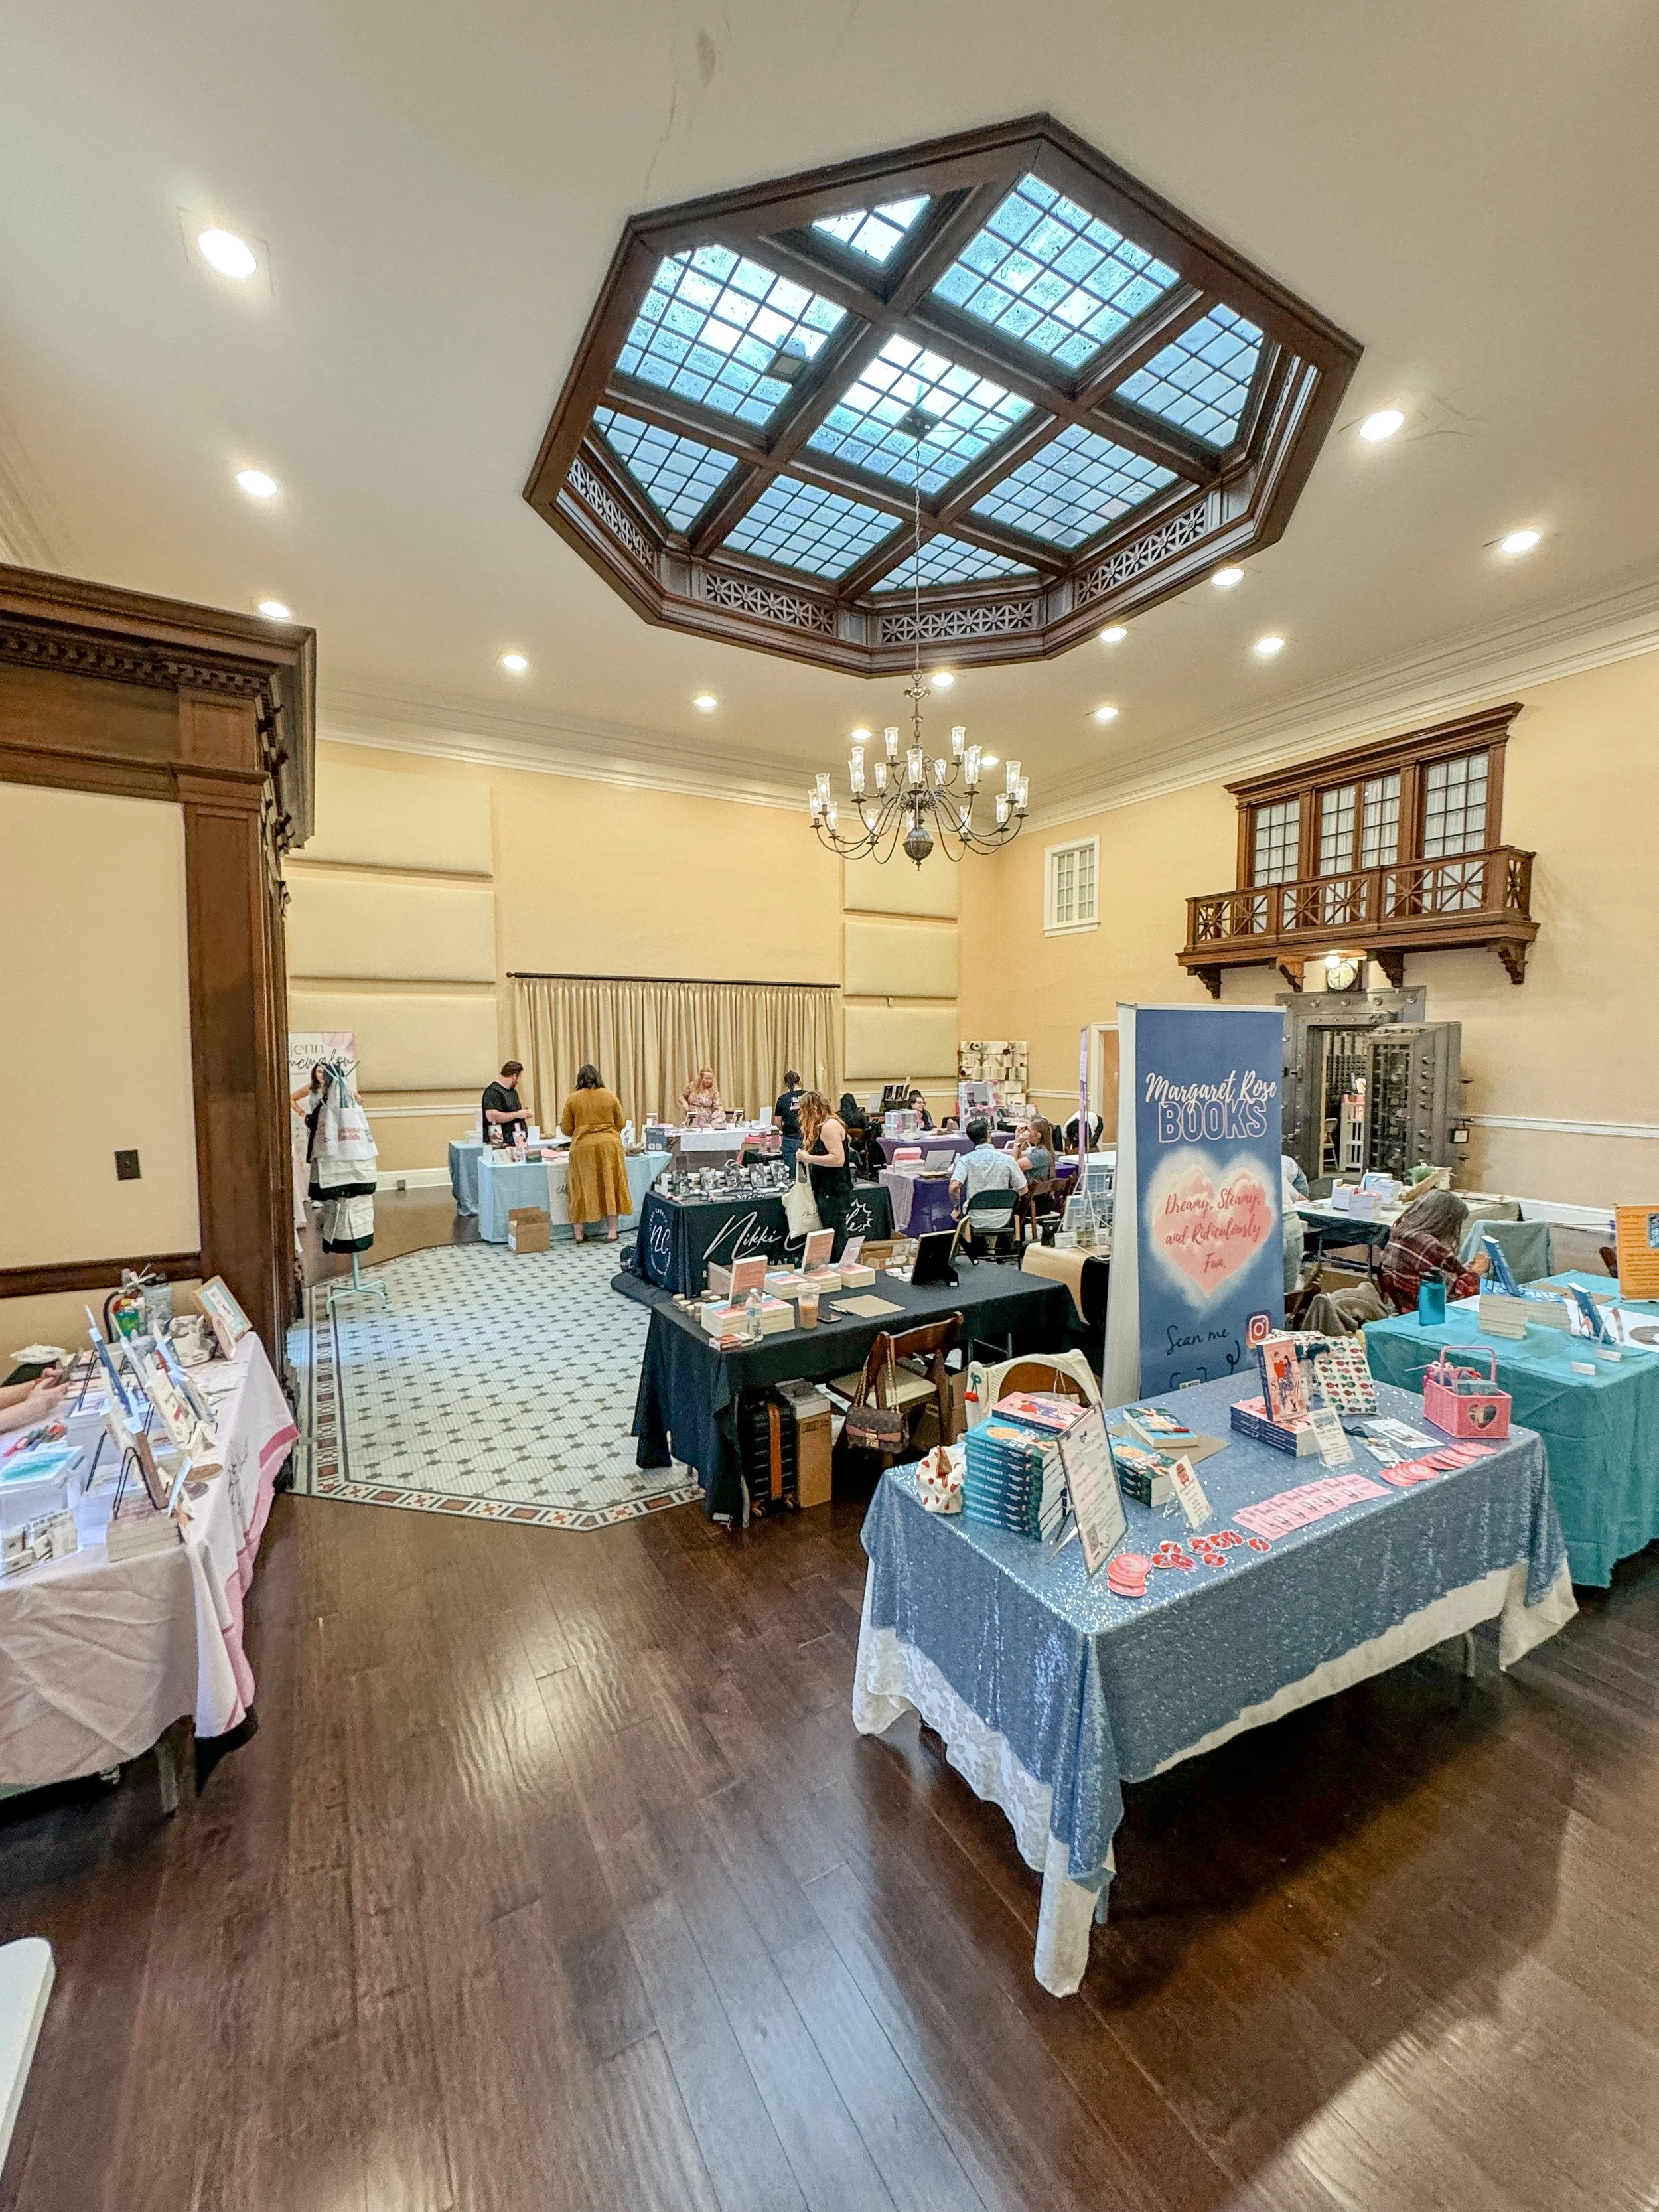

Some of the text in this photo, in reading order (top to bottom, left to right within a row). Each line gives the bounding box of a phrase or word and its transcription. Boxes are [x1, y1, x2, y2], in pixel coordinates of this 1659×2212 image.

[1145, 1070, 1277, 1113] Margaret Rose
[1158, 1097, 1267, 1143] BOOKS
[1165, 1188, 1261, 1218] Dreamy, Steamy,
[703, 1211, 782, 1260] Nikki
[1165, 1214, 1262, 1246] and Ridiculously
[1204, 1252, 1226, 1273] Fun.
[1166, 1325, 1230, 1355] Scan me
